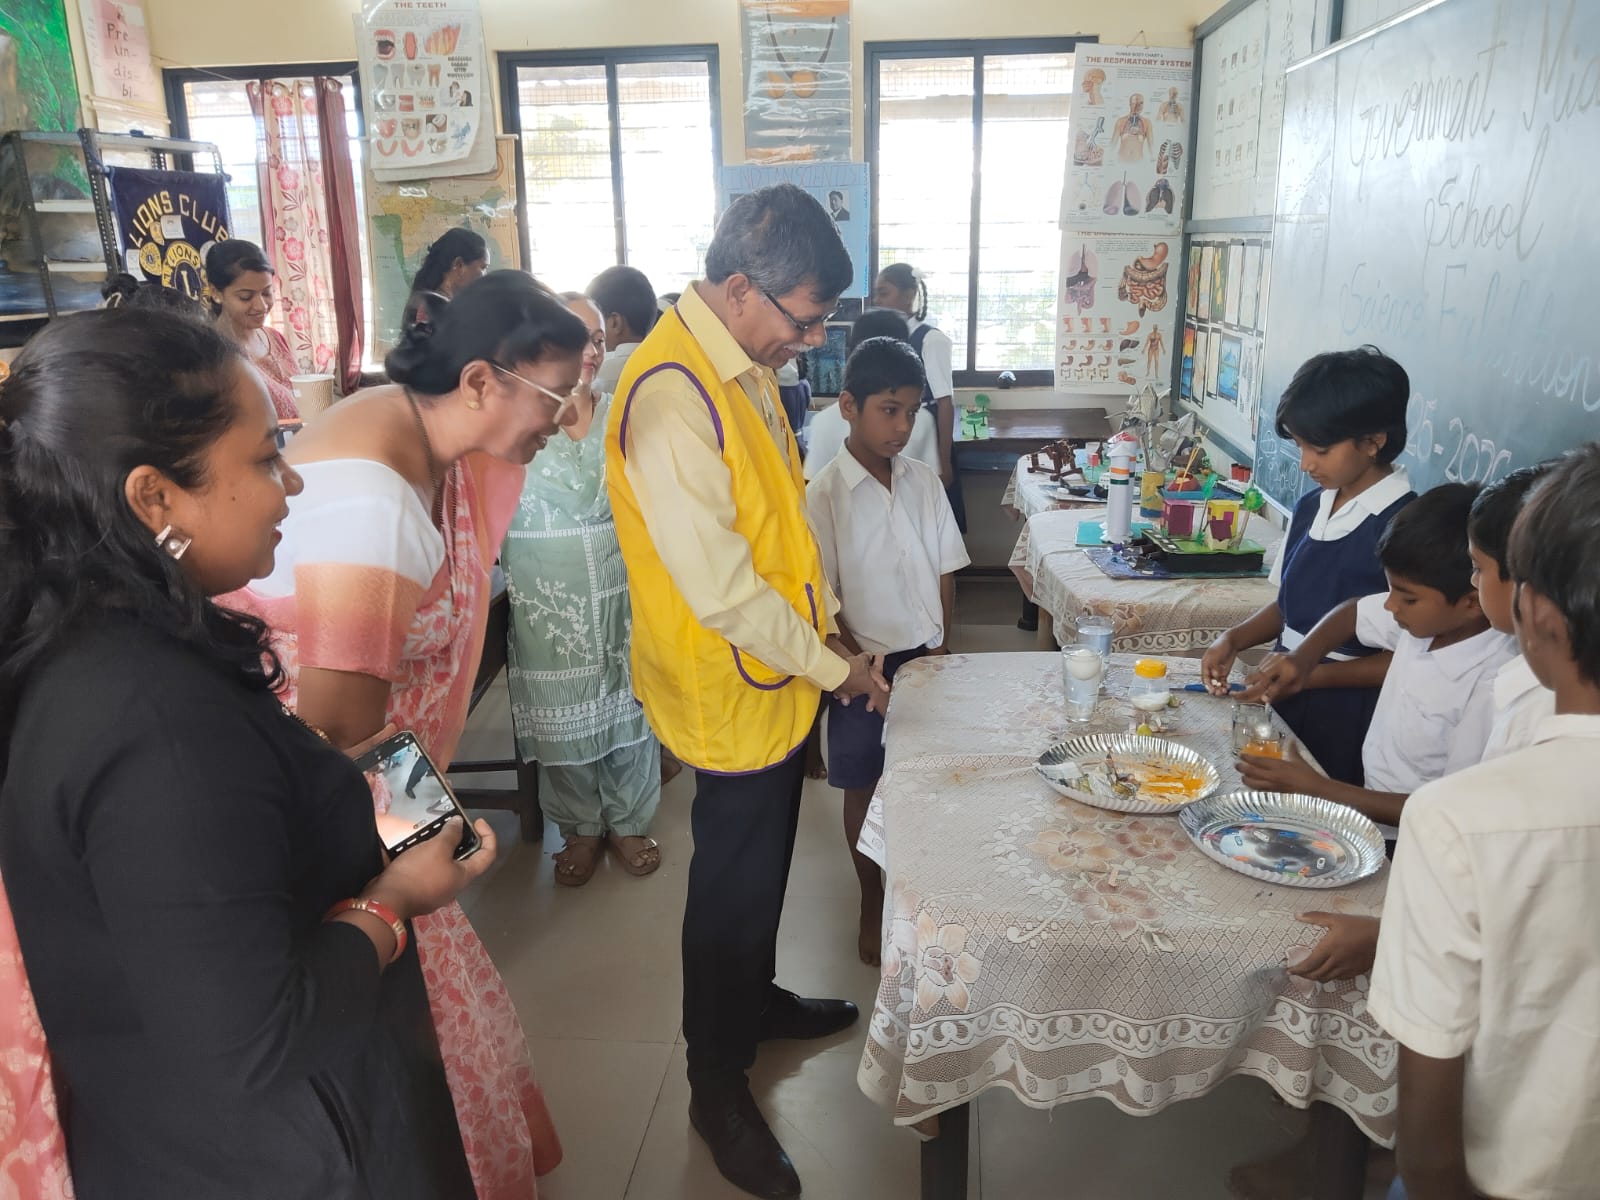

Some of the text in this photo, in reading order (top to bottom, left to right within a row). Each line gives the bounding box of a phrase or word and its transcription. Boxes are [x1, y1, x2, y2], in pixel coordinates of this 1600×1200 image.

[1104, 57, 1158, 66] RESPIRATORY
[1160, 60, 1192, 68] SYSTEM
[129, 190, 229, 248] LIONS CLUB
[1422, 122, 1546, 298] School
[168, 245, 199, 266] LIONS
[180, 270, 199, 301] L
[1339, 262, 1426, 340] Science
